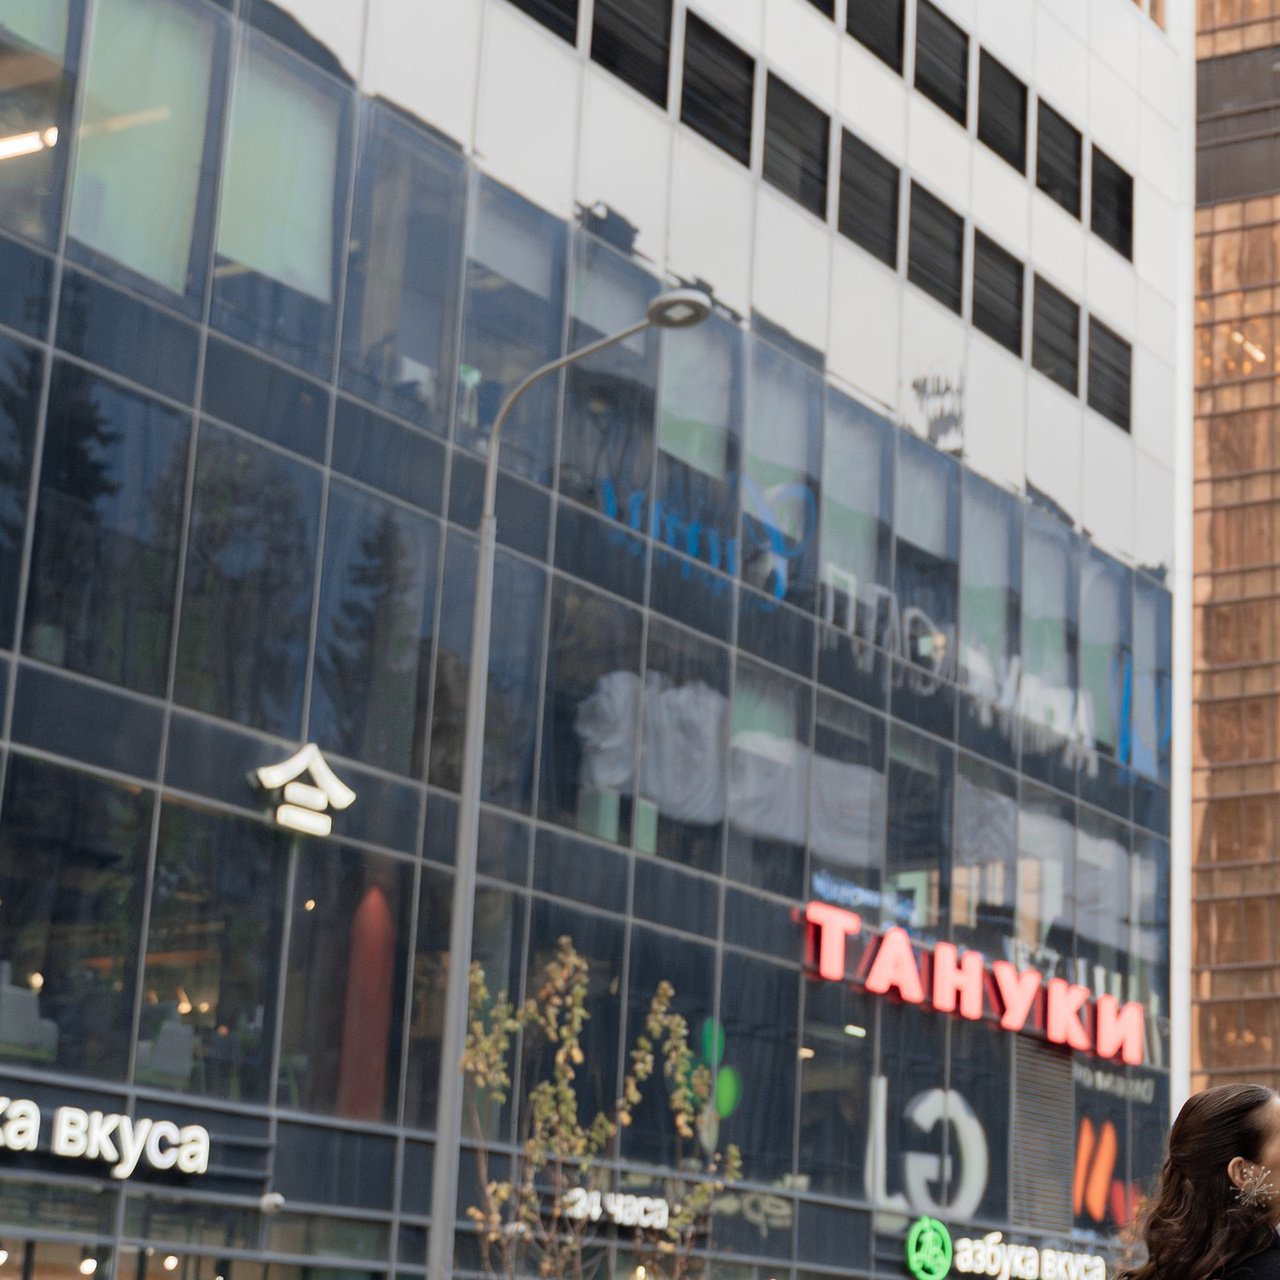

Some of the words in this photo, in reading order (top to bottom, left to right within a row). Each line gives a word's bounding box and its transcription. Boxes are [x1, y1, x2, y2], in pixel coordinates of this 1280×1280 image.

[803, 901, 1144, 1065] ТАНУКИ
[54, 1106, 210, 1179] вкуса
[604, 1192, 669, 1229] часа
